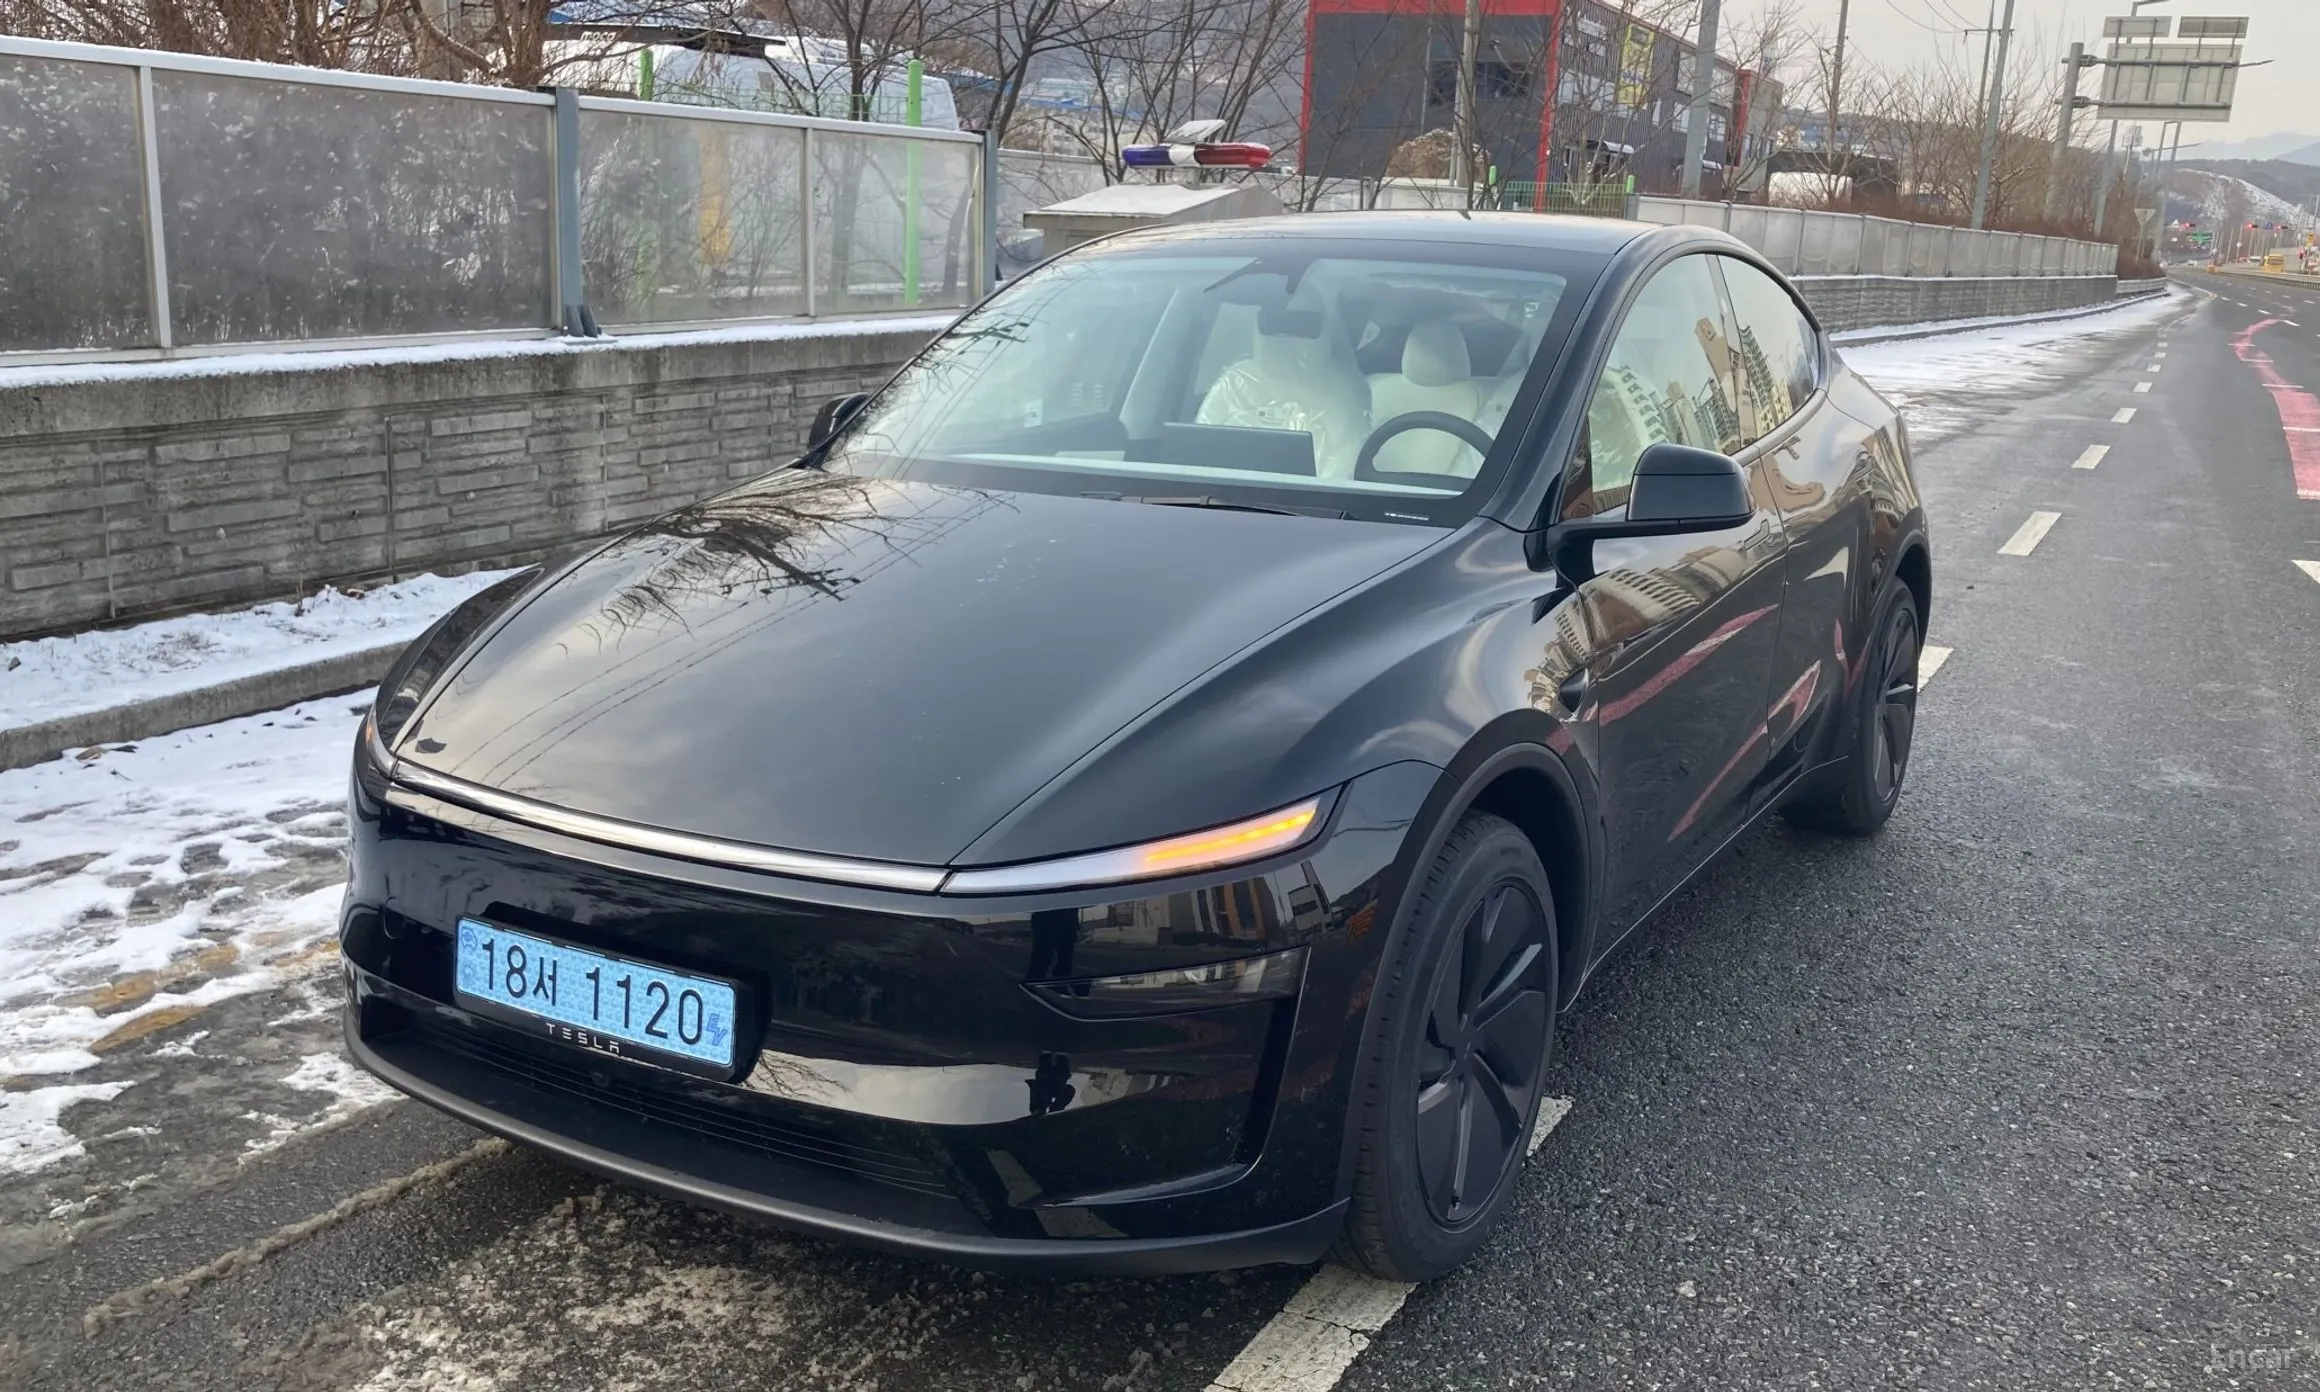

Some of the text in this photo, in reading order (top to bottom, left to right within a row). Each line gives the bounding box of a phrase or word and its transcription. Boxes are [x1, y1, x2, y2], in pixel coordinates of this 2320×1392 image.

[482, 938, 703, 1045] 18서 1120
[546, 1022, 620, 1053] TESLA
[706, 1012, 728, 1046] EV
